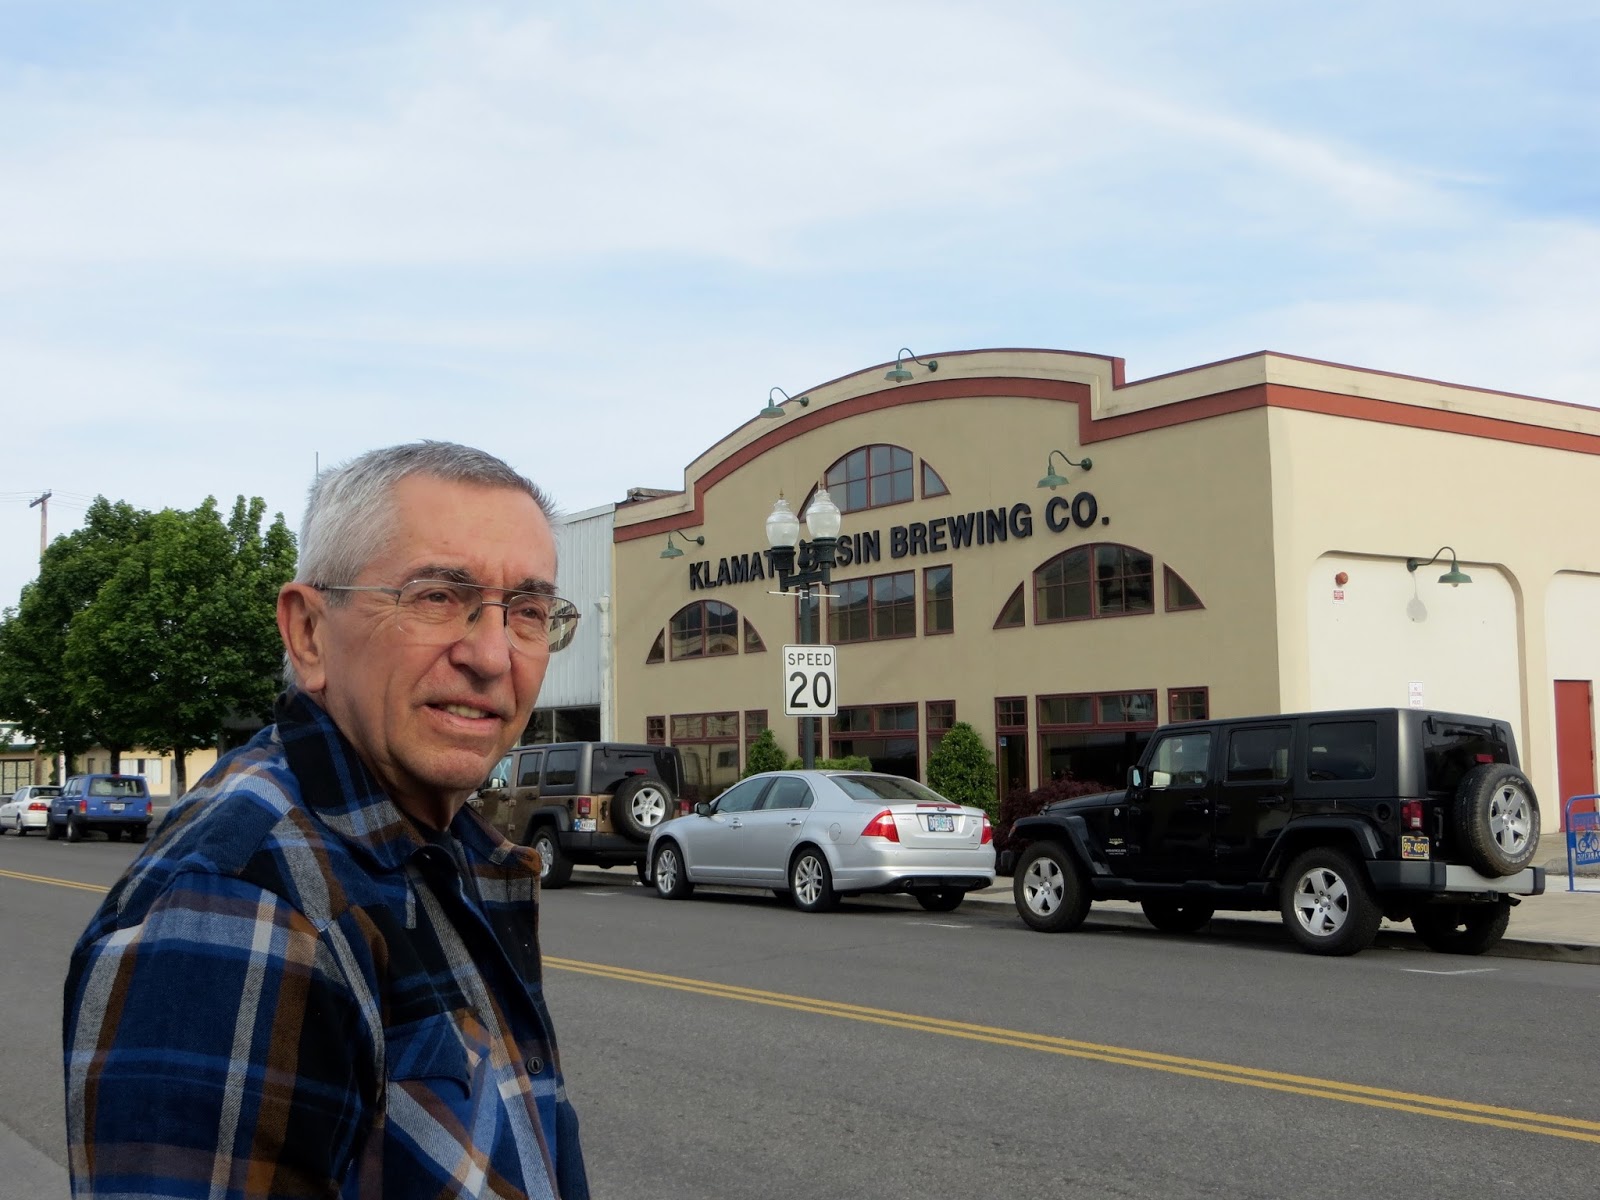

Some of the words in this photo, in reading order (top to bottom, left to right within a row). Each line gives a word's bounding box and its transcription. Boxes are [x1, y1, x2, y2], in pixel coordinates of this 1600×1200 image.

[689, 549, 794, 591] KLAMAT
[801, 530, 880, 573] BSIN
[890, 503, 1032, 559] BREWING
[1045, 491, 1109, 533] CO.
[788, 653, 832, 666] SPEED
[789, 671, 832, 708] 20
